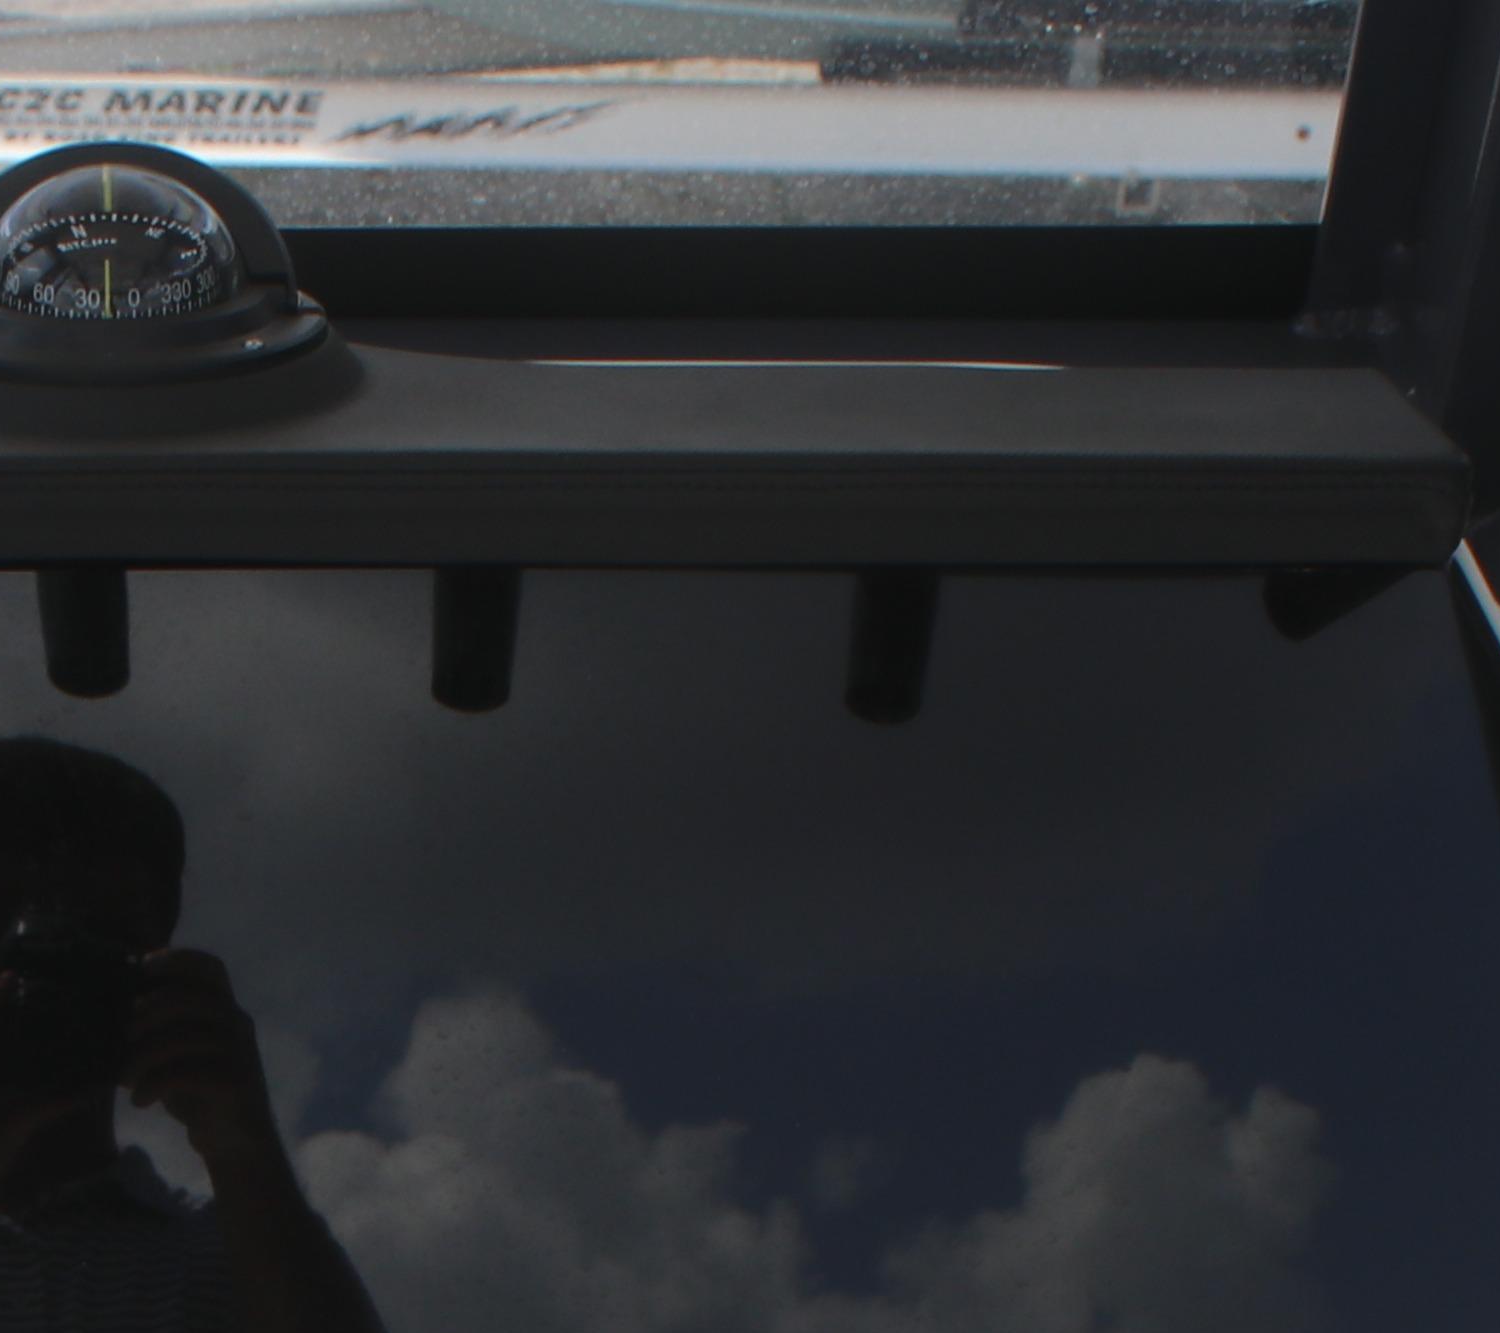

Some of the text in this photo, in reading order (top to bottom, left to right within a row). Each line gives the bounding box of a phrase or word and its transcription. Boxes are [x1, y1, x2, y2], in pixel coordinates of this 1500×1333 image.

[103, 90, 323, 115] MARINE
[33, 284, 55, 305] 60
[75, 288, 101, 310] 30
[127, 288, 141, 308] 0
[161, 282, 192, 304] 330
